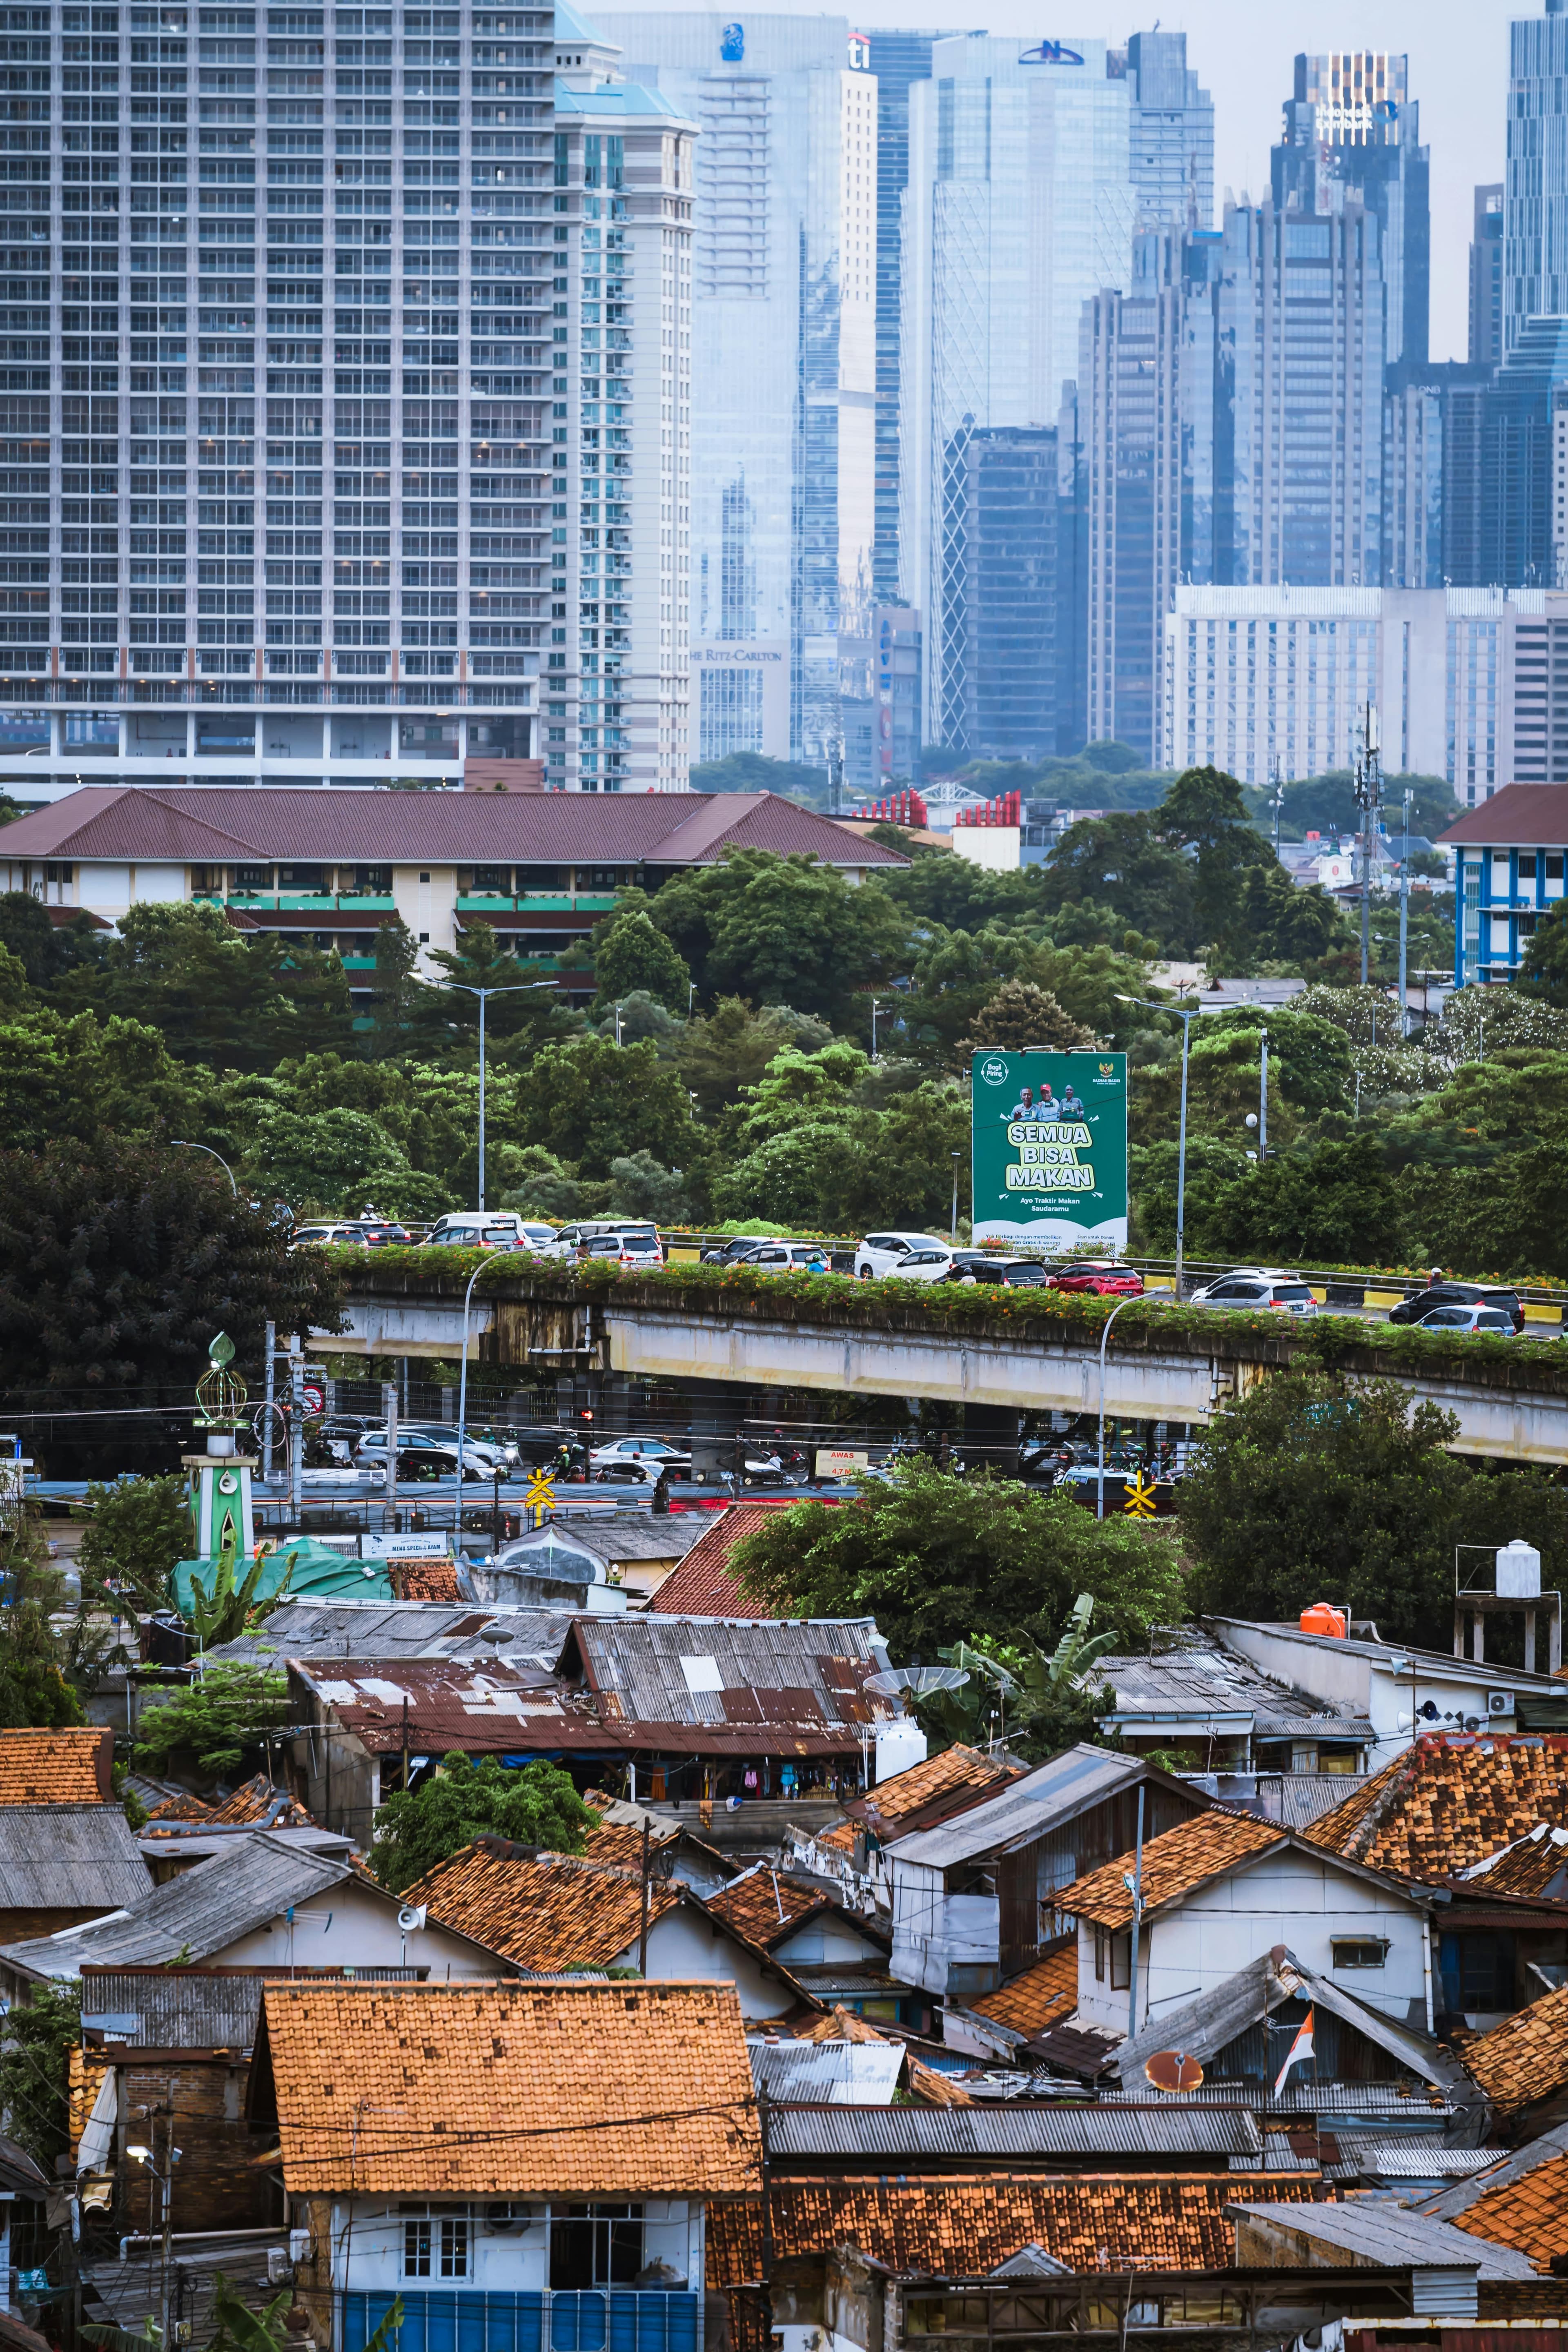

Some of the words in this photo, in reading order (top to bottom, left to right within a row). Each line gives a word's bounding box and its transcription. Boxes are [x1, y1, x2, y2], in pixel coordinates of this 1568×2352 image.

[847, 38, 870, 69] ti
[690, 651, 703, 660] HE
[1011, 1125, 1089, 1144] SEMUA
[1023, 1147, 1075, 1165] BISA
[1009, 1167, 1092, 1188] MAKAN
